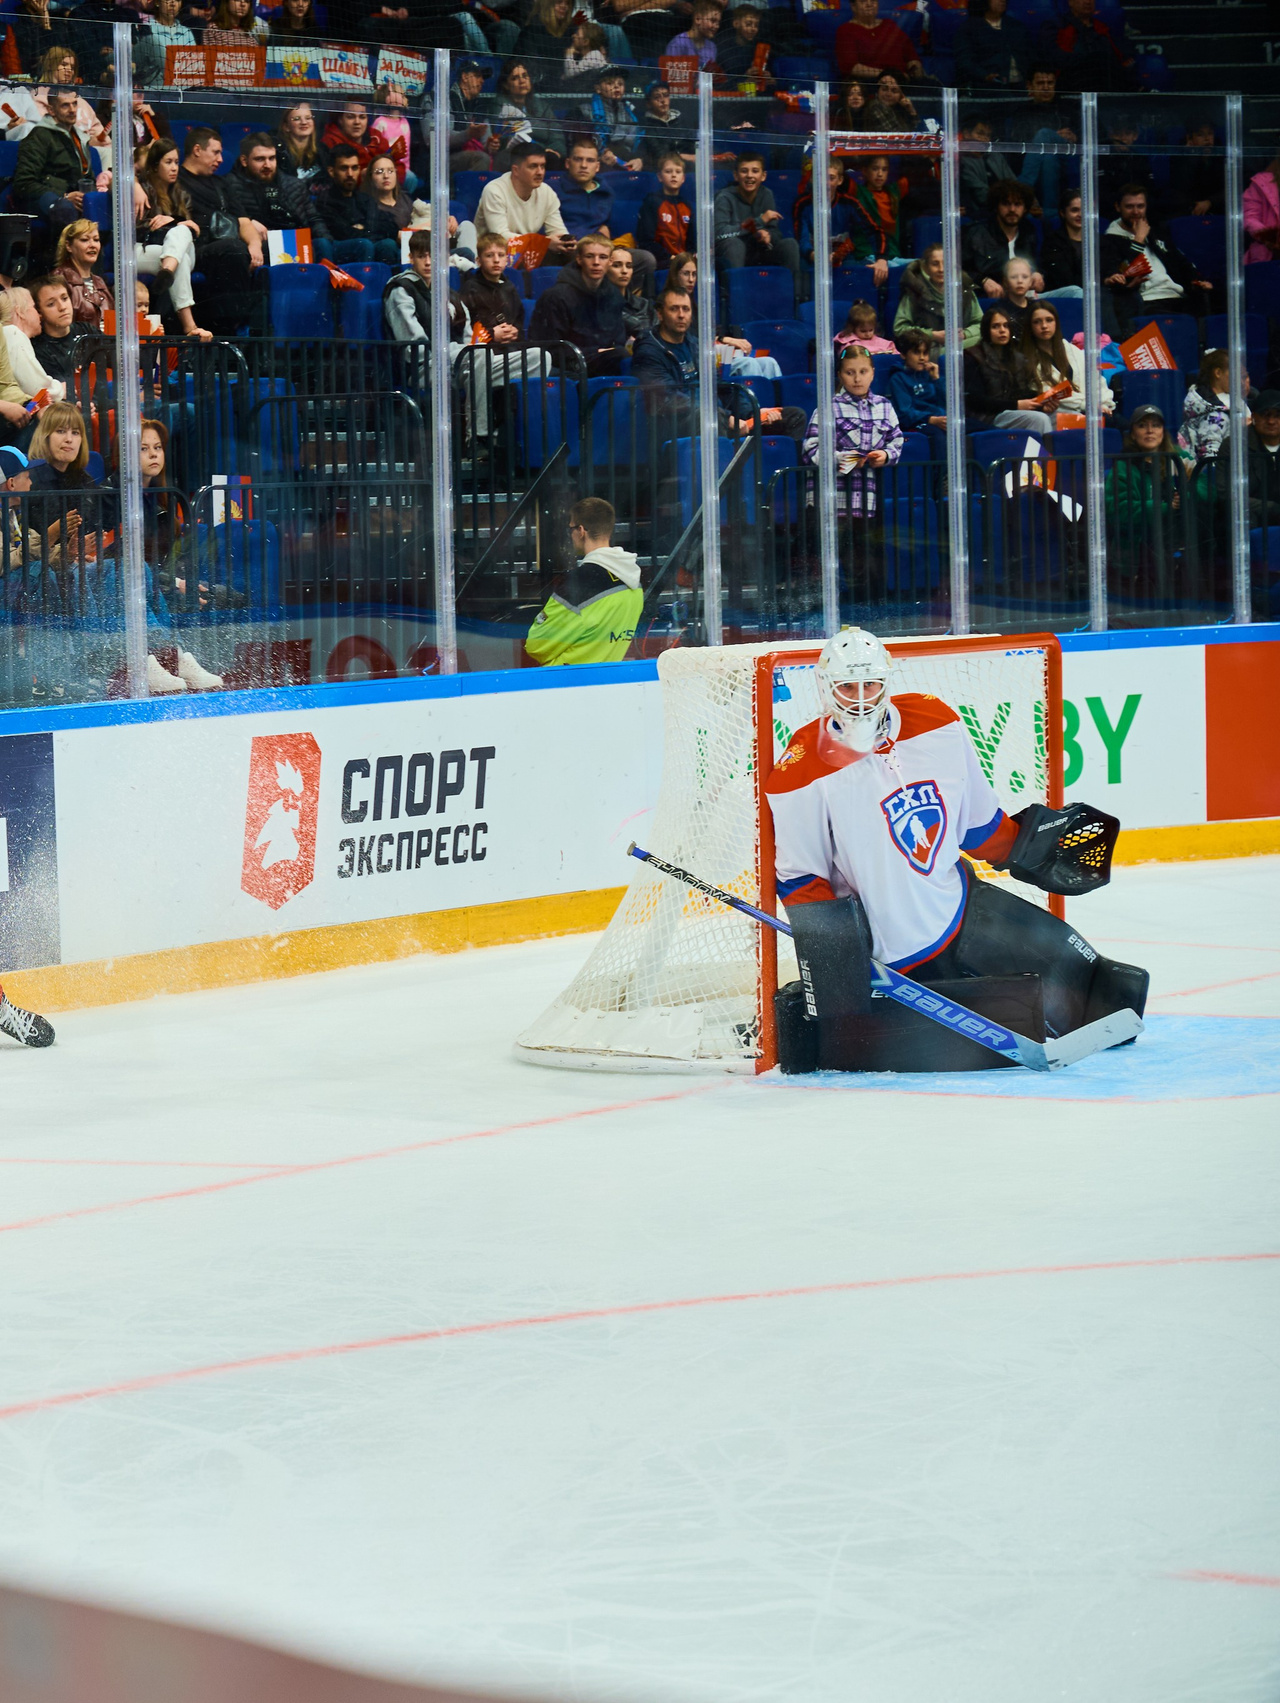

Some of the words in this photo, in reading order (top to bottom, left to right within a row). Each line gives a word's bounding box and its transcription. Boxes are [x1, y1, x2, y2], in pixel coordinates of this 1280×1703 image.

[341, 746, 496, 824] СПОРТ
[337, 822, 488, 879] ЭКСПРЕСС
[1066, 933, 1097, 964] BAUER
[799, 958, 819, 1018] BAUER
[891, 983, 1009, 1047] BAUER
